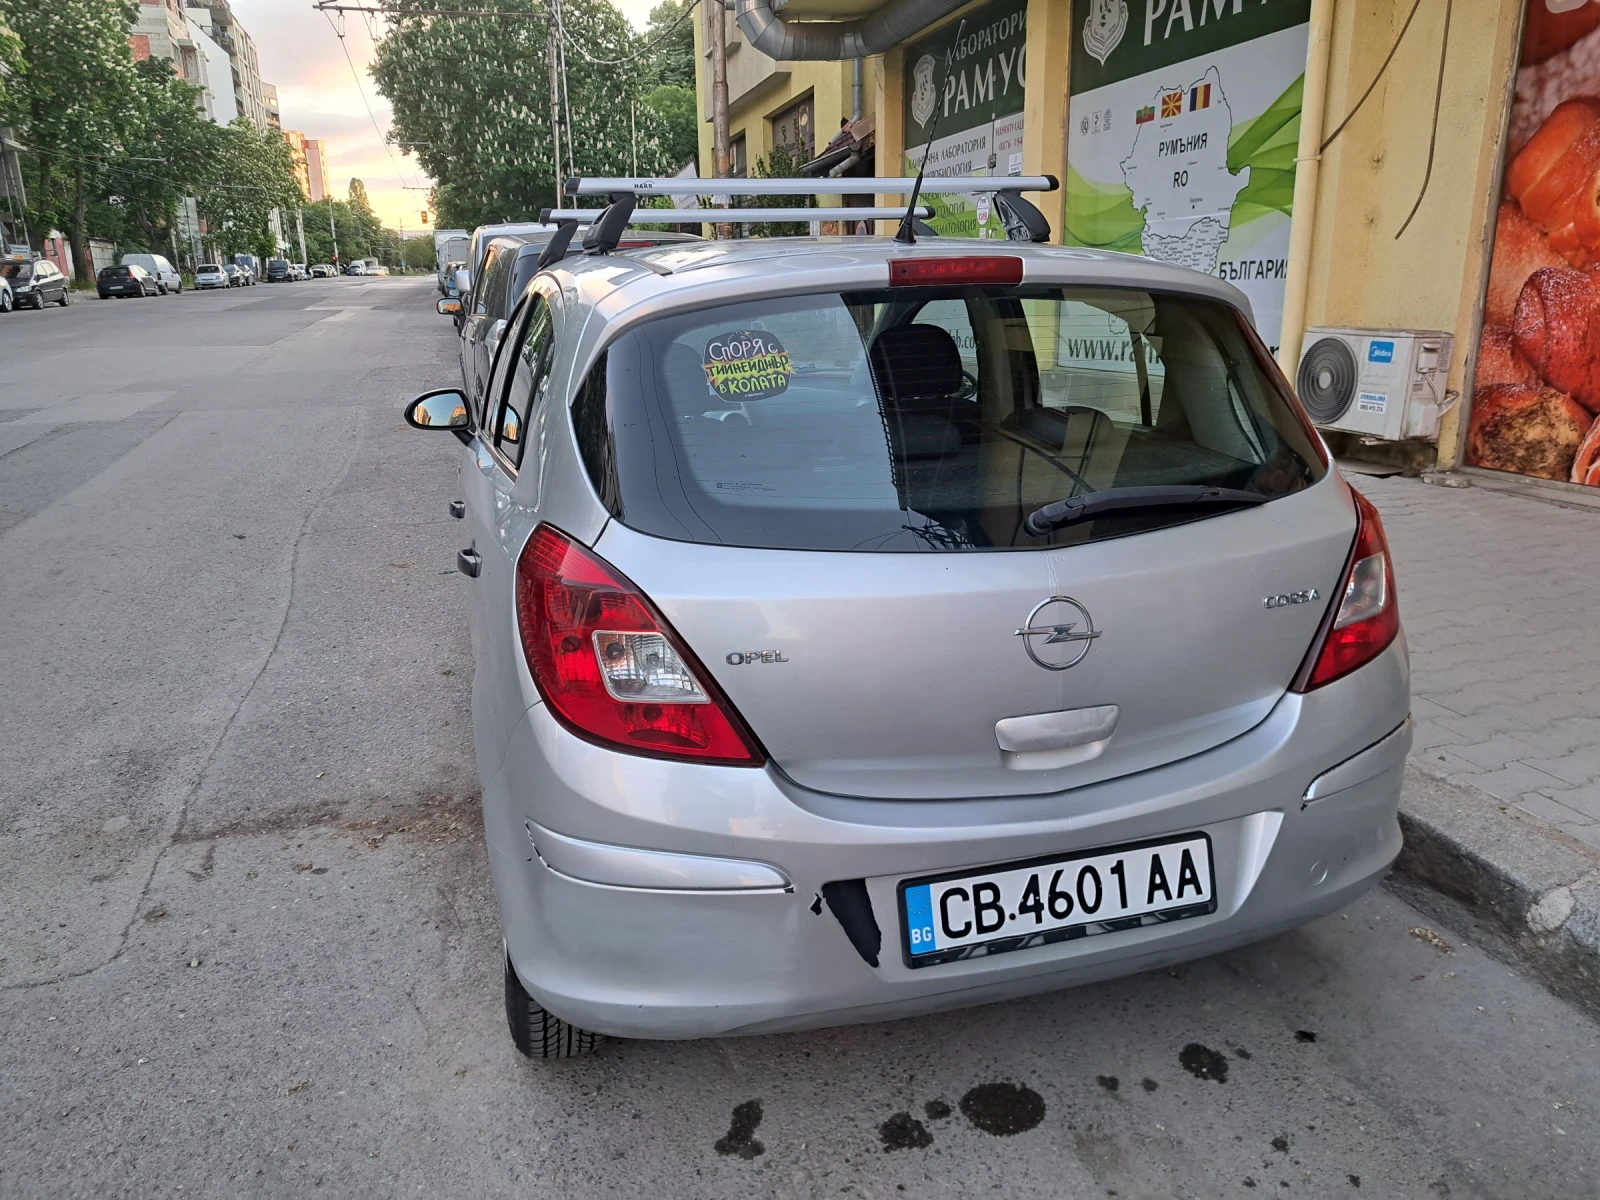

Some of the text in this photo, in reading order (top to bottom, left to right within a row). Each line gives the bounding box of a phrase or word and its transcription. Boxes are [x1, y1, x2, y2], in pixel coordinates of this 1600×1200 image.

[940, 136, 986, 161] ЛАБОРАТОРИЯ
[1158, 132, 1208, 157] РУМЪНИЯ
[1173, 170, 1188, 188] RO
[728, 373, 786, 394] КОЛАТА
[1264, 588, 1320, 609] CORSA
[725, 649, 790, 665] OPEL
[911, 927, 933, 944] BG
